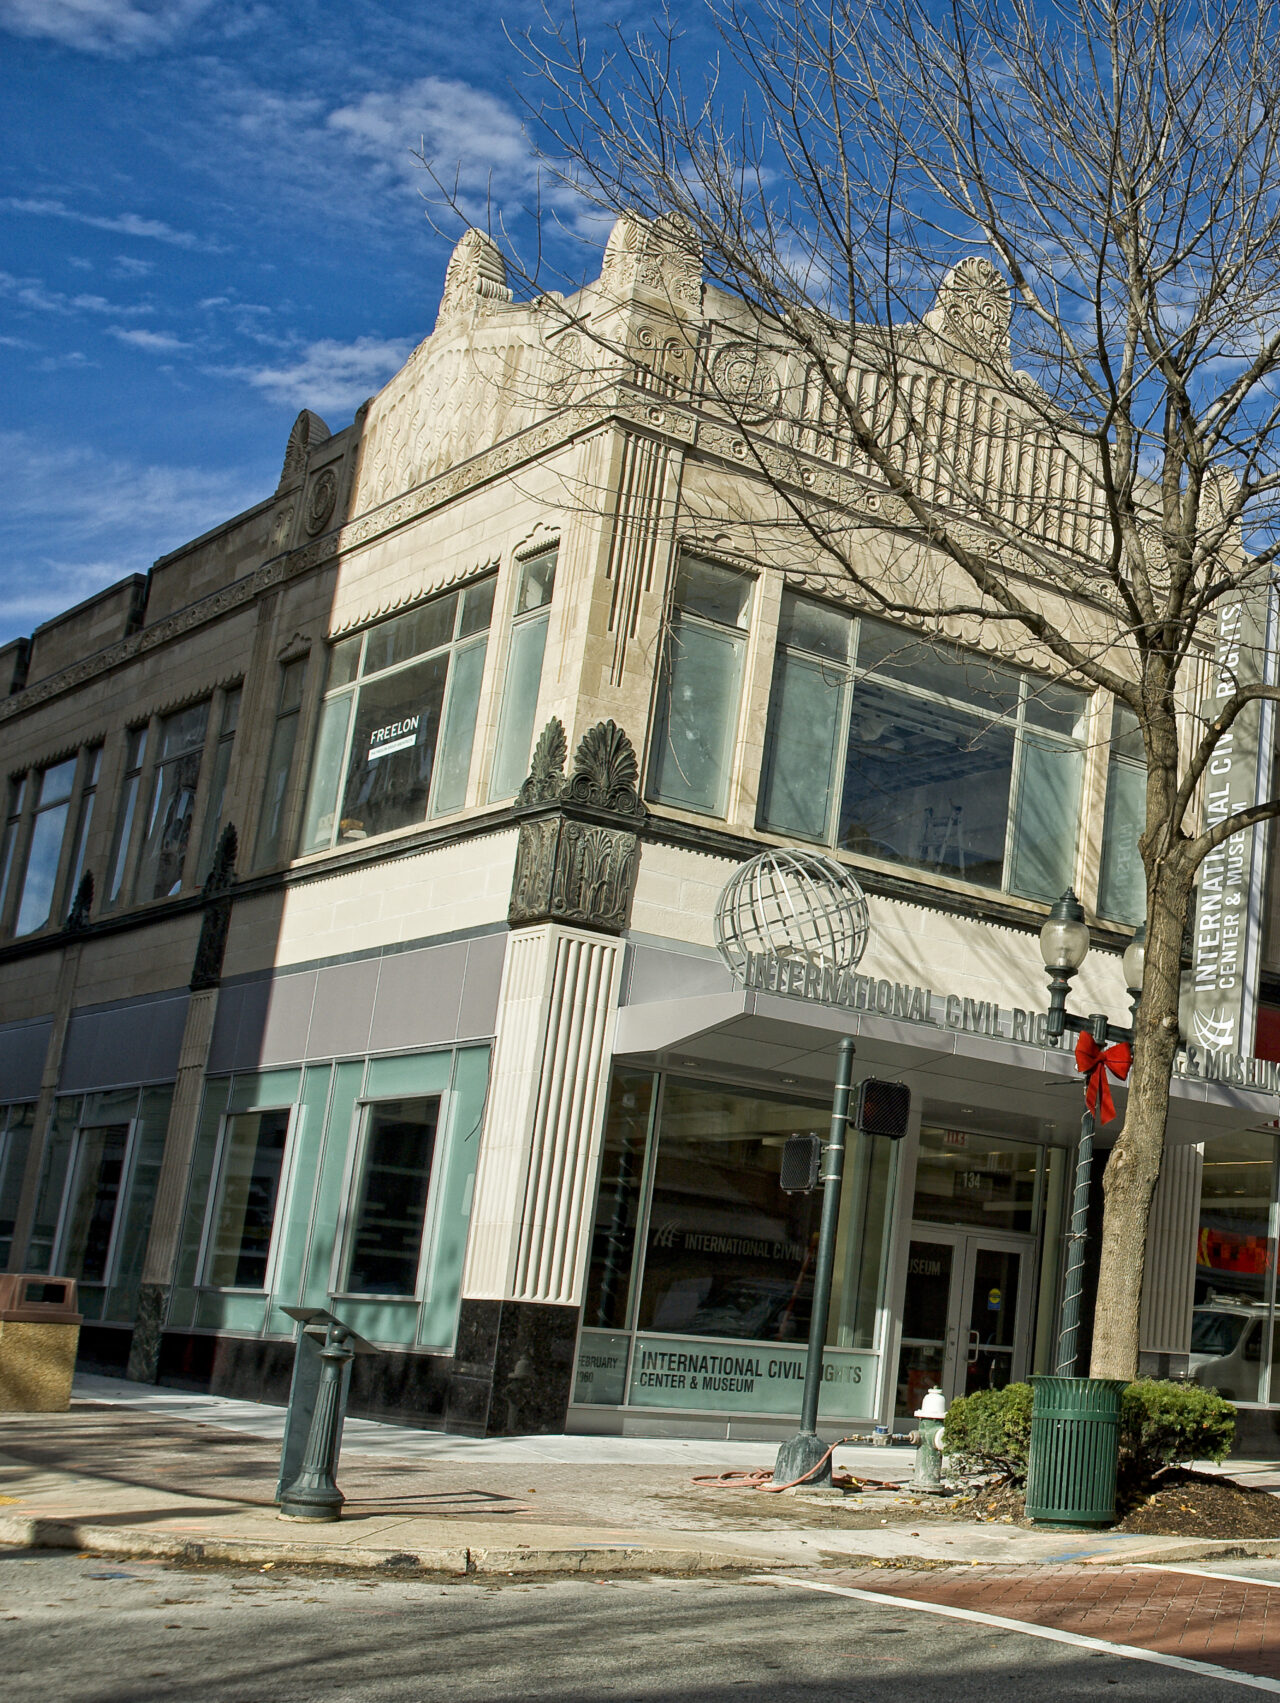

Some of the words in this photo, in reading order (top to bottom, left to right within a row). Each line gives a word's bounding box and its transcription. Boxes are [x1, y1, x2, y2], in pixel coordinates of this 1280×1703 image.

[1215, 602, 1242, 699] RIGHTS
[369, 715, 420, 745] FREELON
[1226, 801, 1248, 885] MUSEM
[1225, 891, 1241, 905] &
[1218, 912, 1240, 989] CENTER
[743, 950, 936, 1023] INTERNATIONAL
[944, 994, 1004, 1038] CIVIL
[1185, 1045, 1200, 1076] &
[963, 1172, 981, 1189] 134
[684, 1233, 771, 1259] INTERNATIONAL
[773, 1242, 801, 1261] CIVIL
[639, 1372, 686, 1390] CENTER
[689, 1375, 699, 1390] &
[702, 1376, 755, 1394] MUSEUM
[641, 1351, 763, 1377] INTERNATIONAL
[767, 1359, 805, 1380] CIVIL
[820, 1363, 863, 1385] IGHTS
